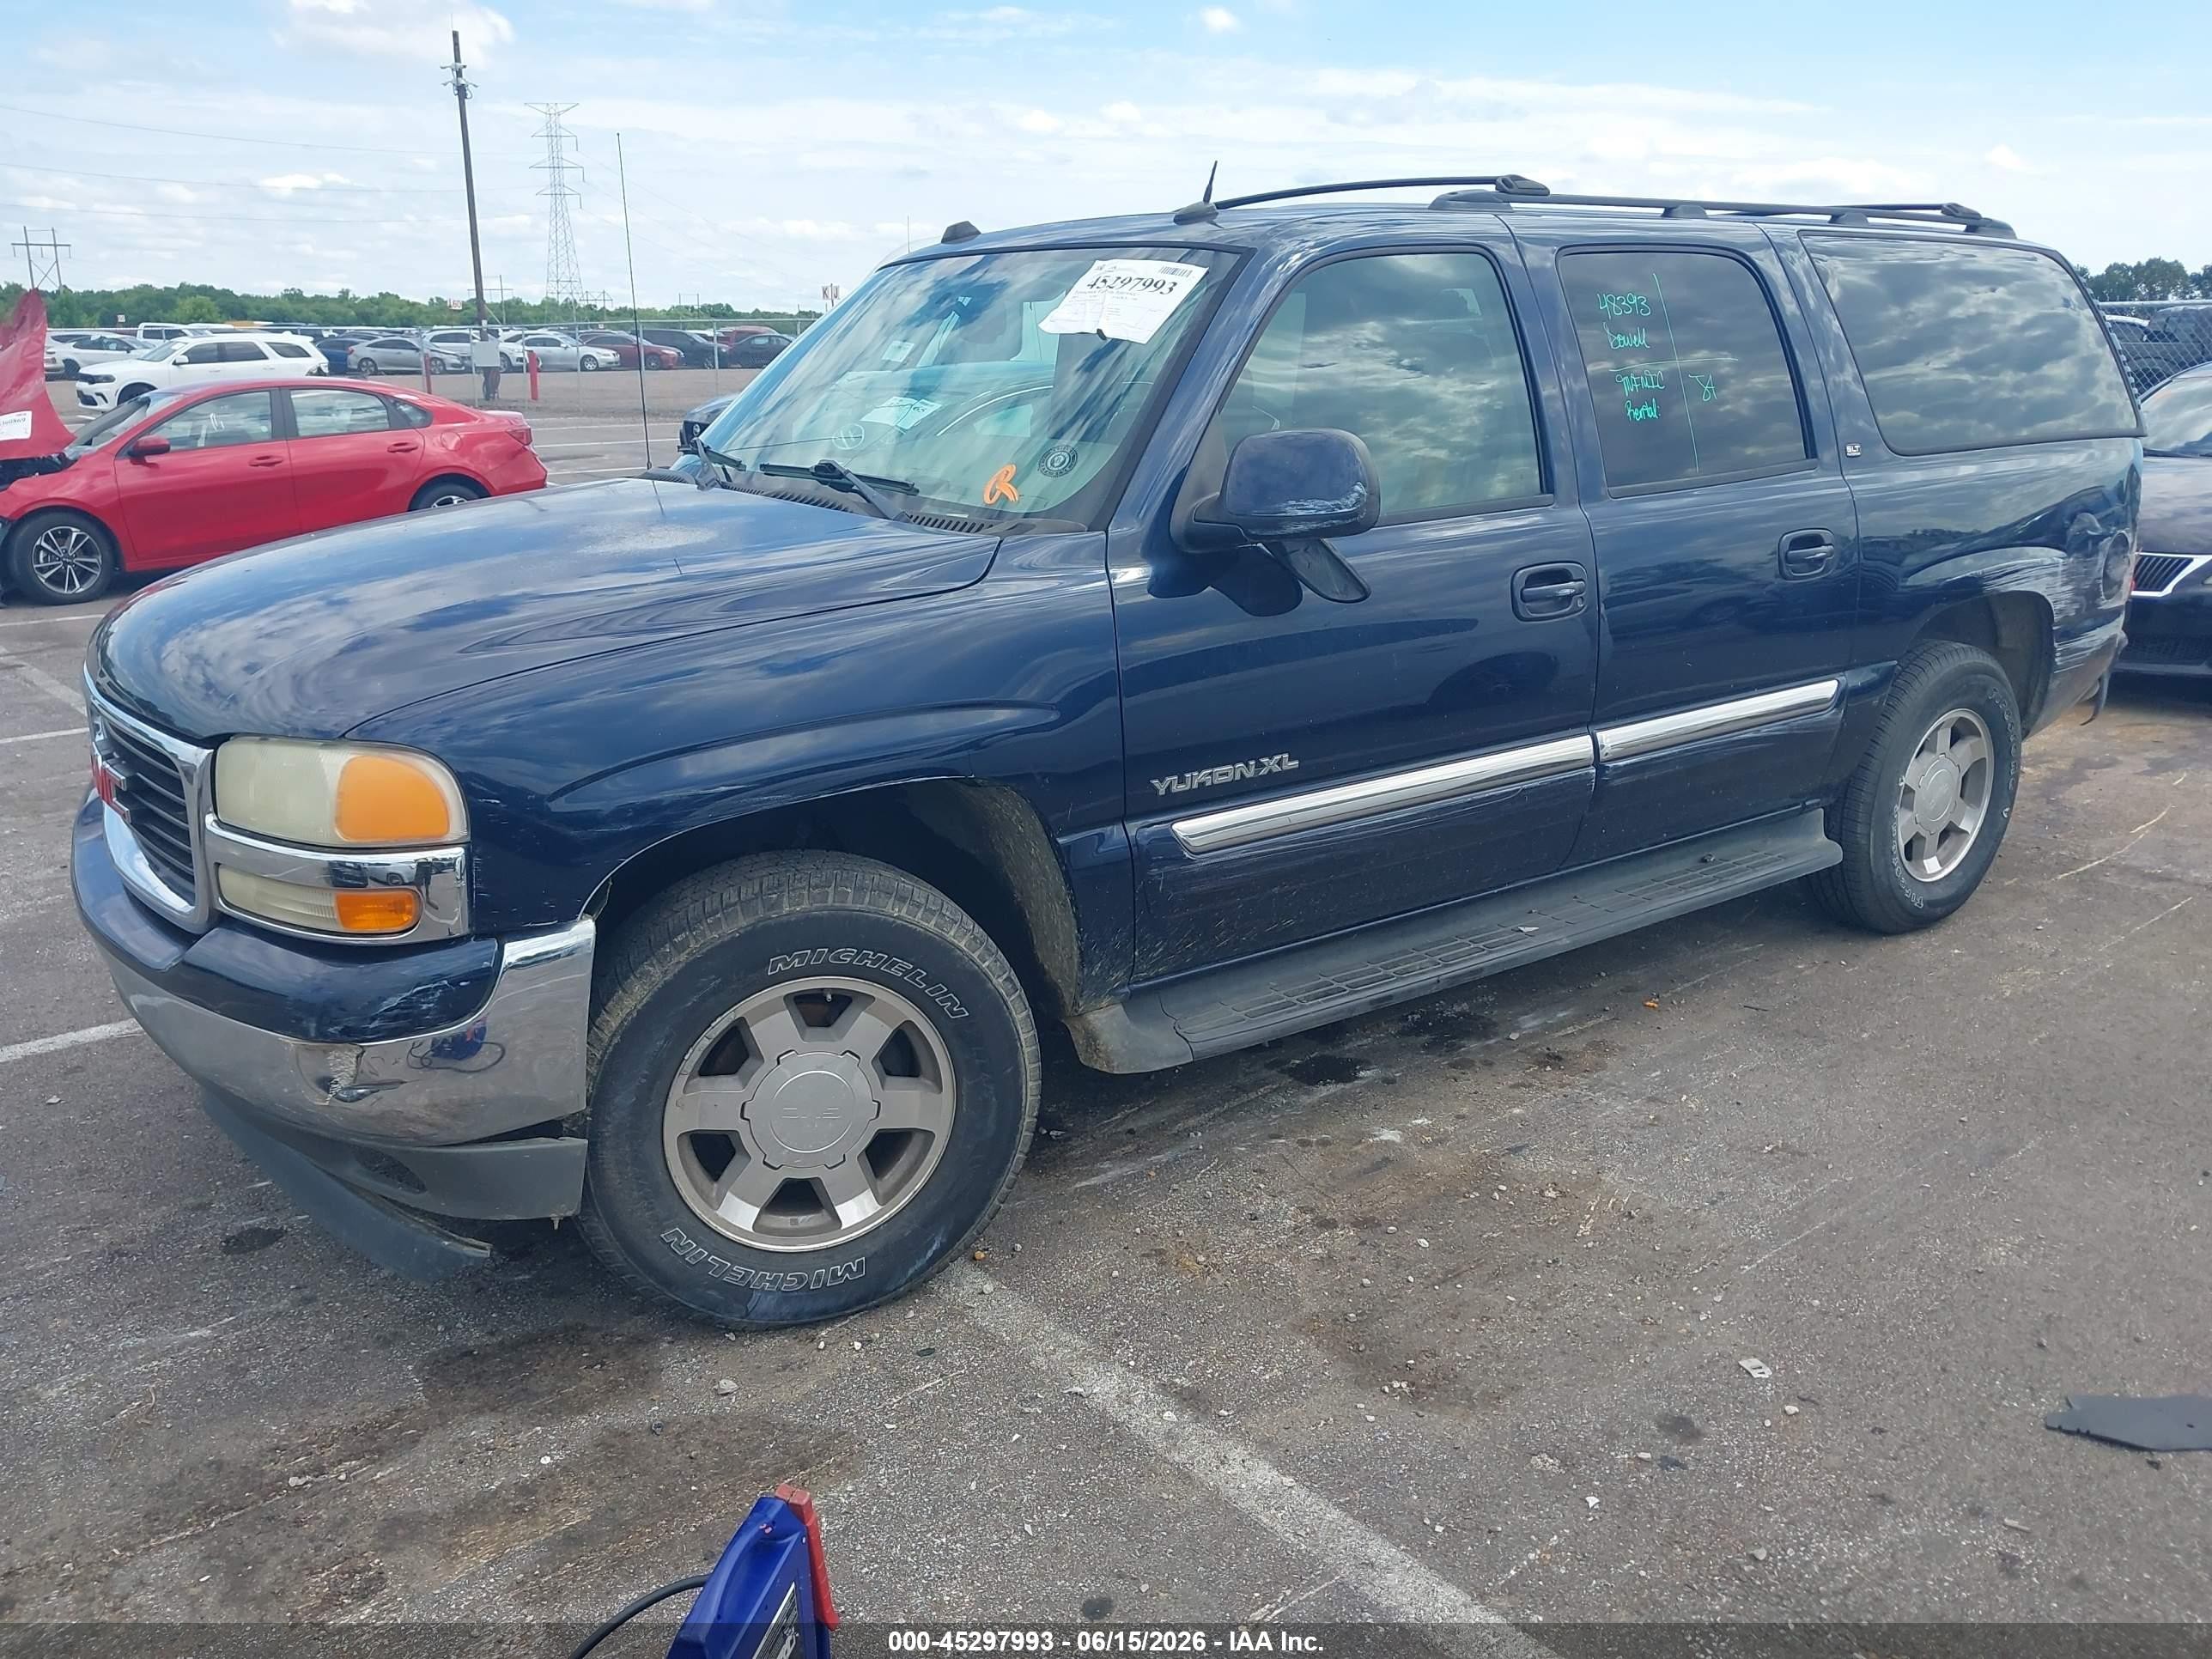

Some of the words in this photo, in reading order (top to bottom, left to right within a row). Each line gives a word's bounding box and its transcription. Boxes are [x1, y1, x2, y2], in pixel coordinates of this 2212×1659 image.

[1087, 275, 1178, 295] 45297993
[1596, 293, 1651, 320] 48393
[1149, 759, 1256, 797] YUKON
[1256, 751, 1300, 777] XL
[767, 947, 969, 1019] MICHELIN
[659, 1227, 866, 1291] MICHELIN
